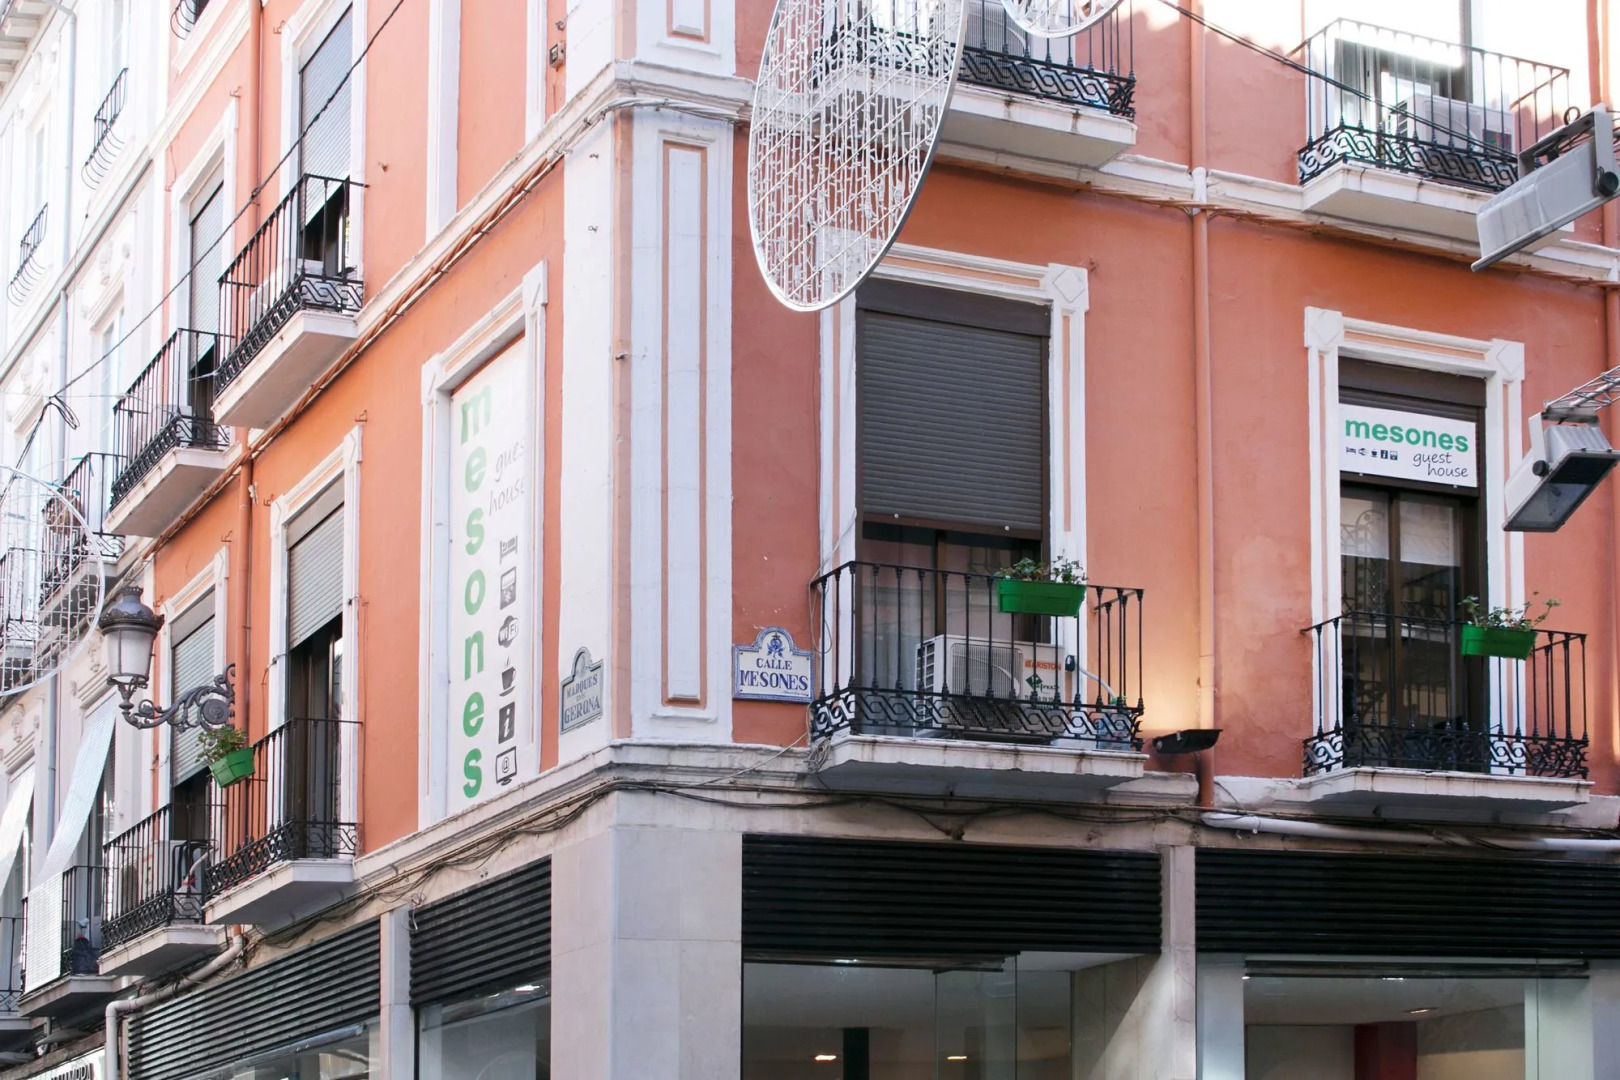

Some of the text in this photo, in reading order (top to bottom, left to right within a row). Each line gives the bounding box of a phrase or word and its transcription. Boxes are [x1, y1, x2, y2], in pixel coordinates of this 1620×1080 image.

[1345, 419, 1469, 452] mesones
[494, 441, 525, 483] gues
[1413, 452, 1452, 467] guest
[1427, 463, 1469, 477] house
[460, 385, 492, 799] mesones
[756, 658, 792, 671] CALLE
[566, 673, 598, 698] MARQUES
[739, 670, 809, 691] MESONES
[564, 695, 600, 724] GERONA
